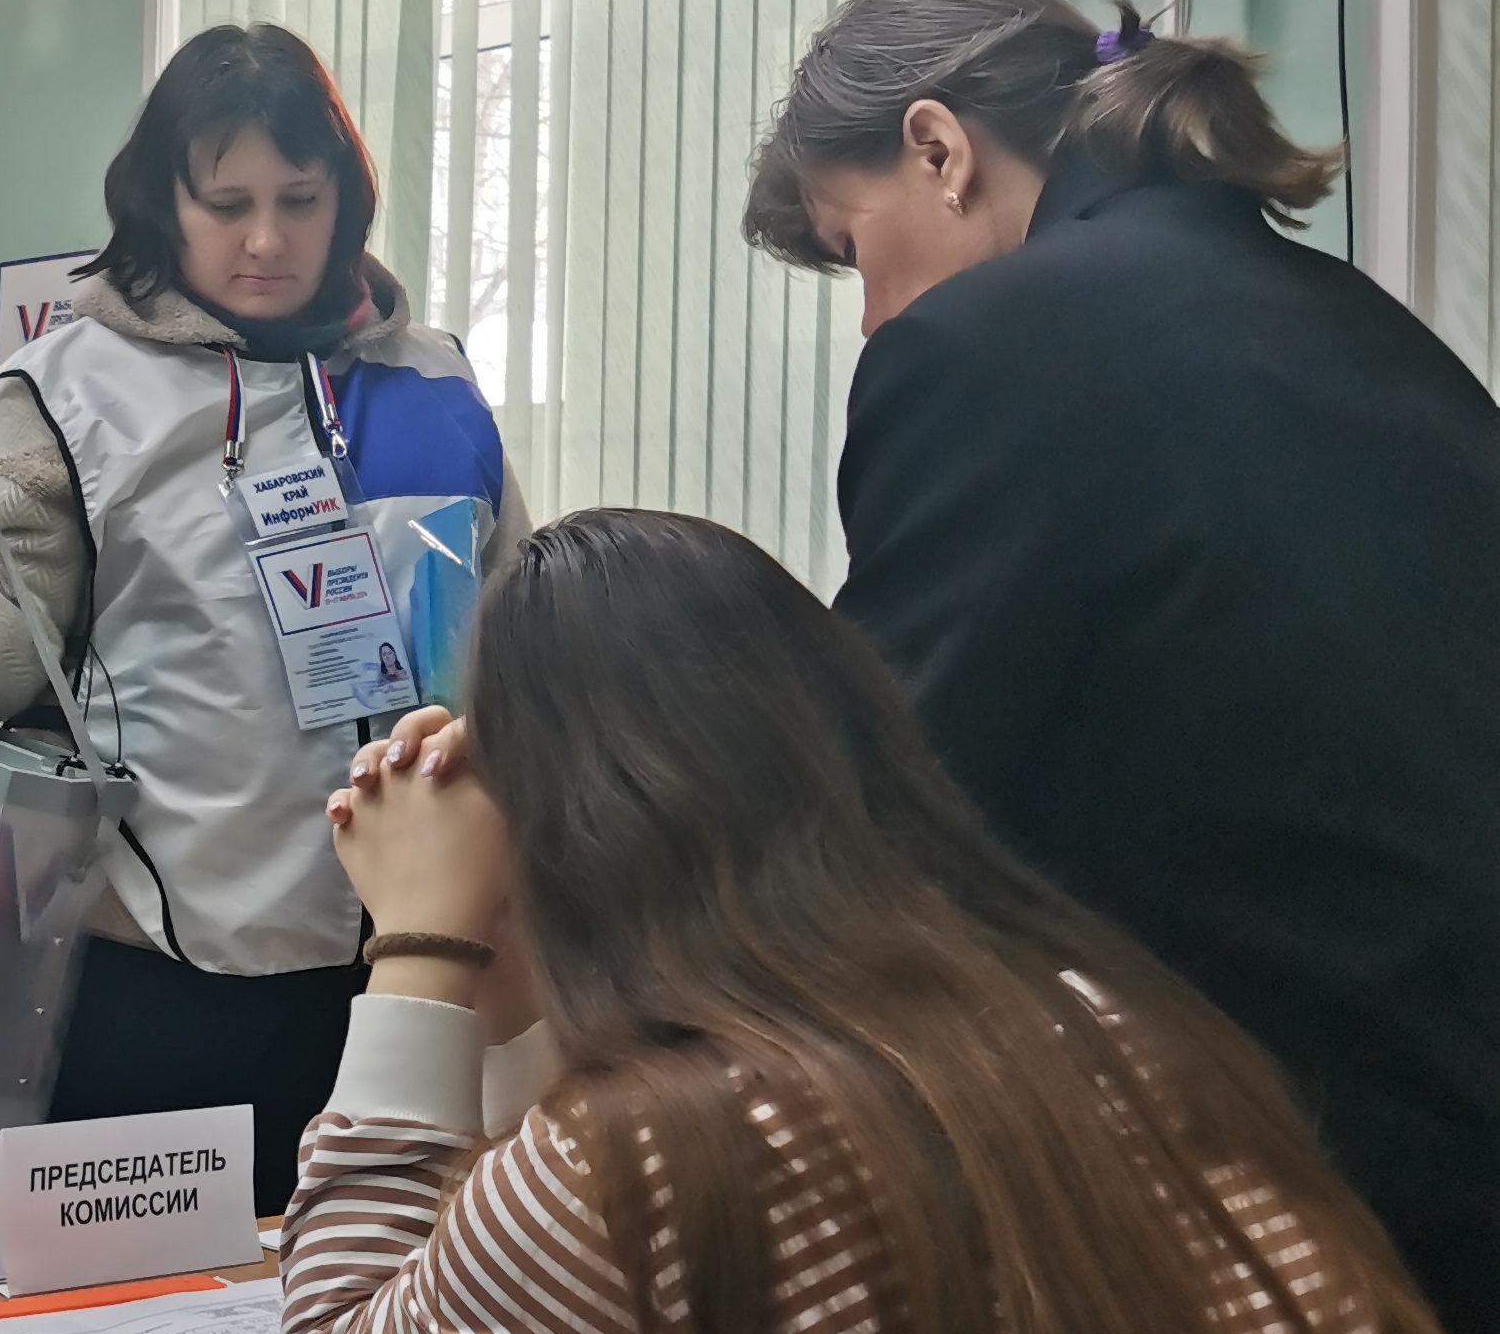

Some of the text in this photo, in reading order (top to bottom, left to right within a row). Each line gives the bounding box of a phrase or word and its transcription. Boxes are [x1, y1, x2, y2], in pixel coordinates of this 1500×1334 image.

[253, 465, 326, 493] ХАБАРОВСКИЙ
[282, 485, 310, 502] КРАЙ
[261, 497, 340, 526] ИнформУИК
[30, 1148, 226, 1193] ПРЕДСЕДАТЕЛЬ
[60, 1187, 199, 1228] КОМИССИИ
